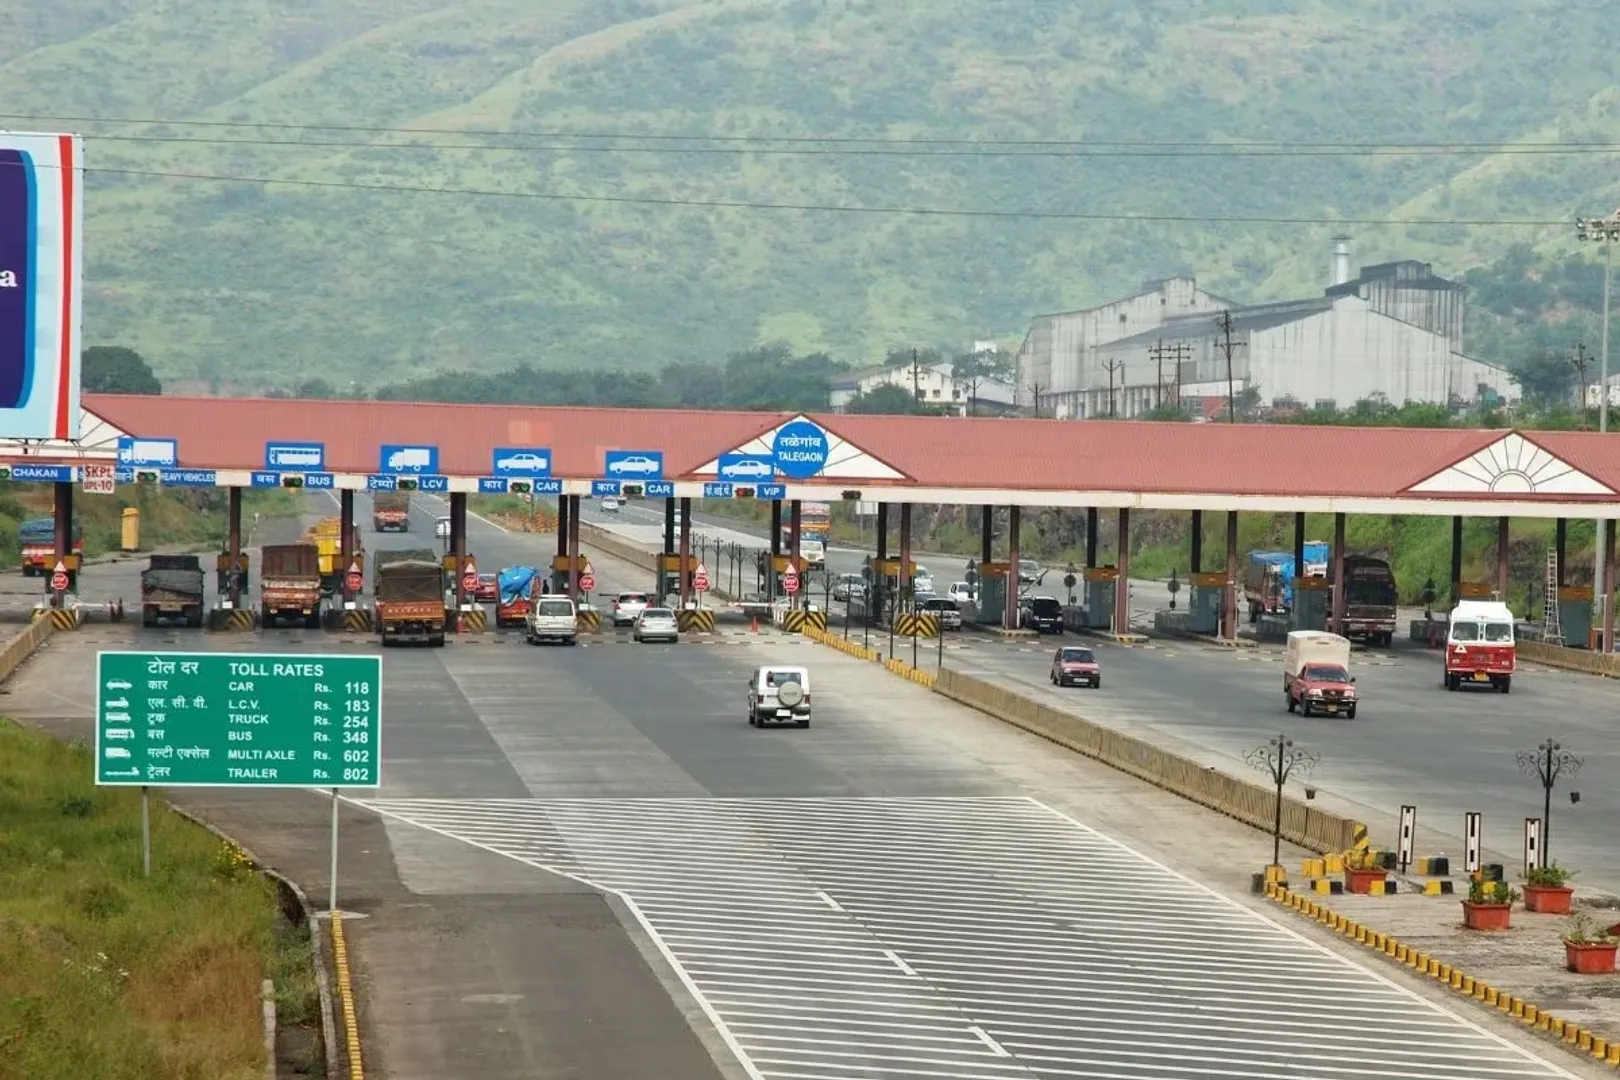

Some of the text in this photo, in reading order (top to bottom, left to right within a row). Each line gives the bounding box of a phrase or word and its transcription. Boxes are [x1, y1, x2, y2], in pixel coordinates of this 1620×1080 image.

[778, 451, 823, 462] TALEGAON
[13, 468, 58, 477] CHAKAN
[182, 472, 215, 481] VEHICLES
[307, 476, 330, 485] BUS
[422, 479, 443, 488] LCV
[483, 480, 503, 490] कार
[536, 482, 558, 491] CAR
[596, 483, 616, 492] कार
[648, 484, 670, 493] CAR
[763, 487, 779, 495] VIP
[147, 656, 199, 674] टोल दर
[229, 663, 323, 676] TOLL RATES
[148, 681, 168, 690] कार
[229, 682, 254, 691] CAR
[315, 682, 369, 695] Rs. 118
[229, 700, 259, 709] L.C.V.
[314, 700, 370, 712] Rs. 183
[228, 714, 268, 724] TRUCK
[314, 716, 368, 728] Rs. 254
[148, 729, 165, 739] बस
[228, 731, 252, 741] BUS
[314, 731, 368, 744] Rs. 348
[228, 749, 295, 760] MULTI AXLE
[314, 750, 369, 762] Rs. 602
[228, 768, 277, 778] TRAILER
[313, 768, 368, 781] Rs. 802
